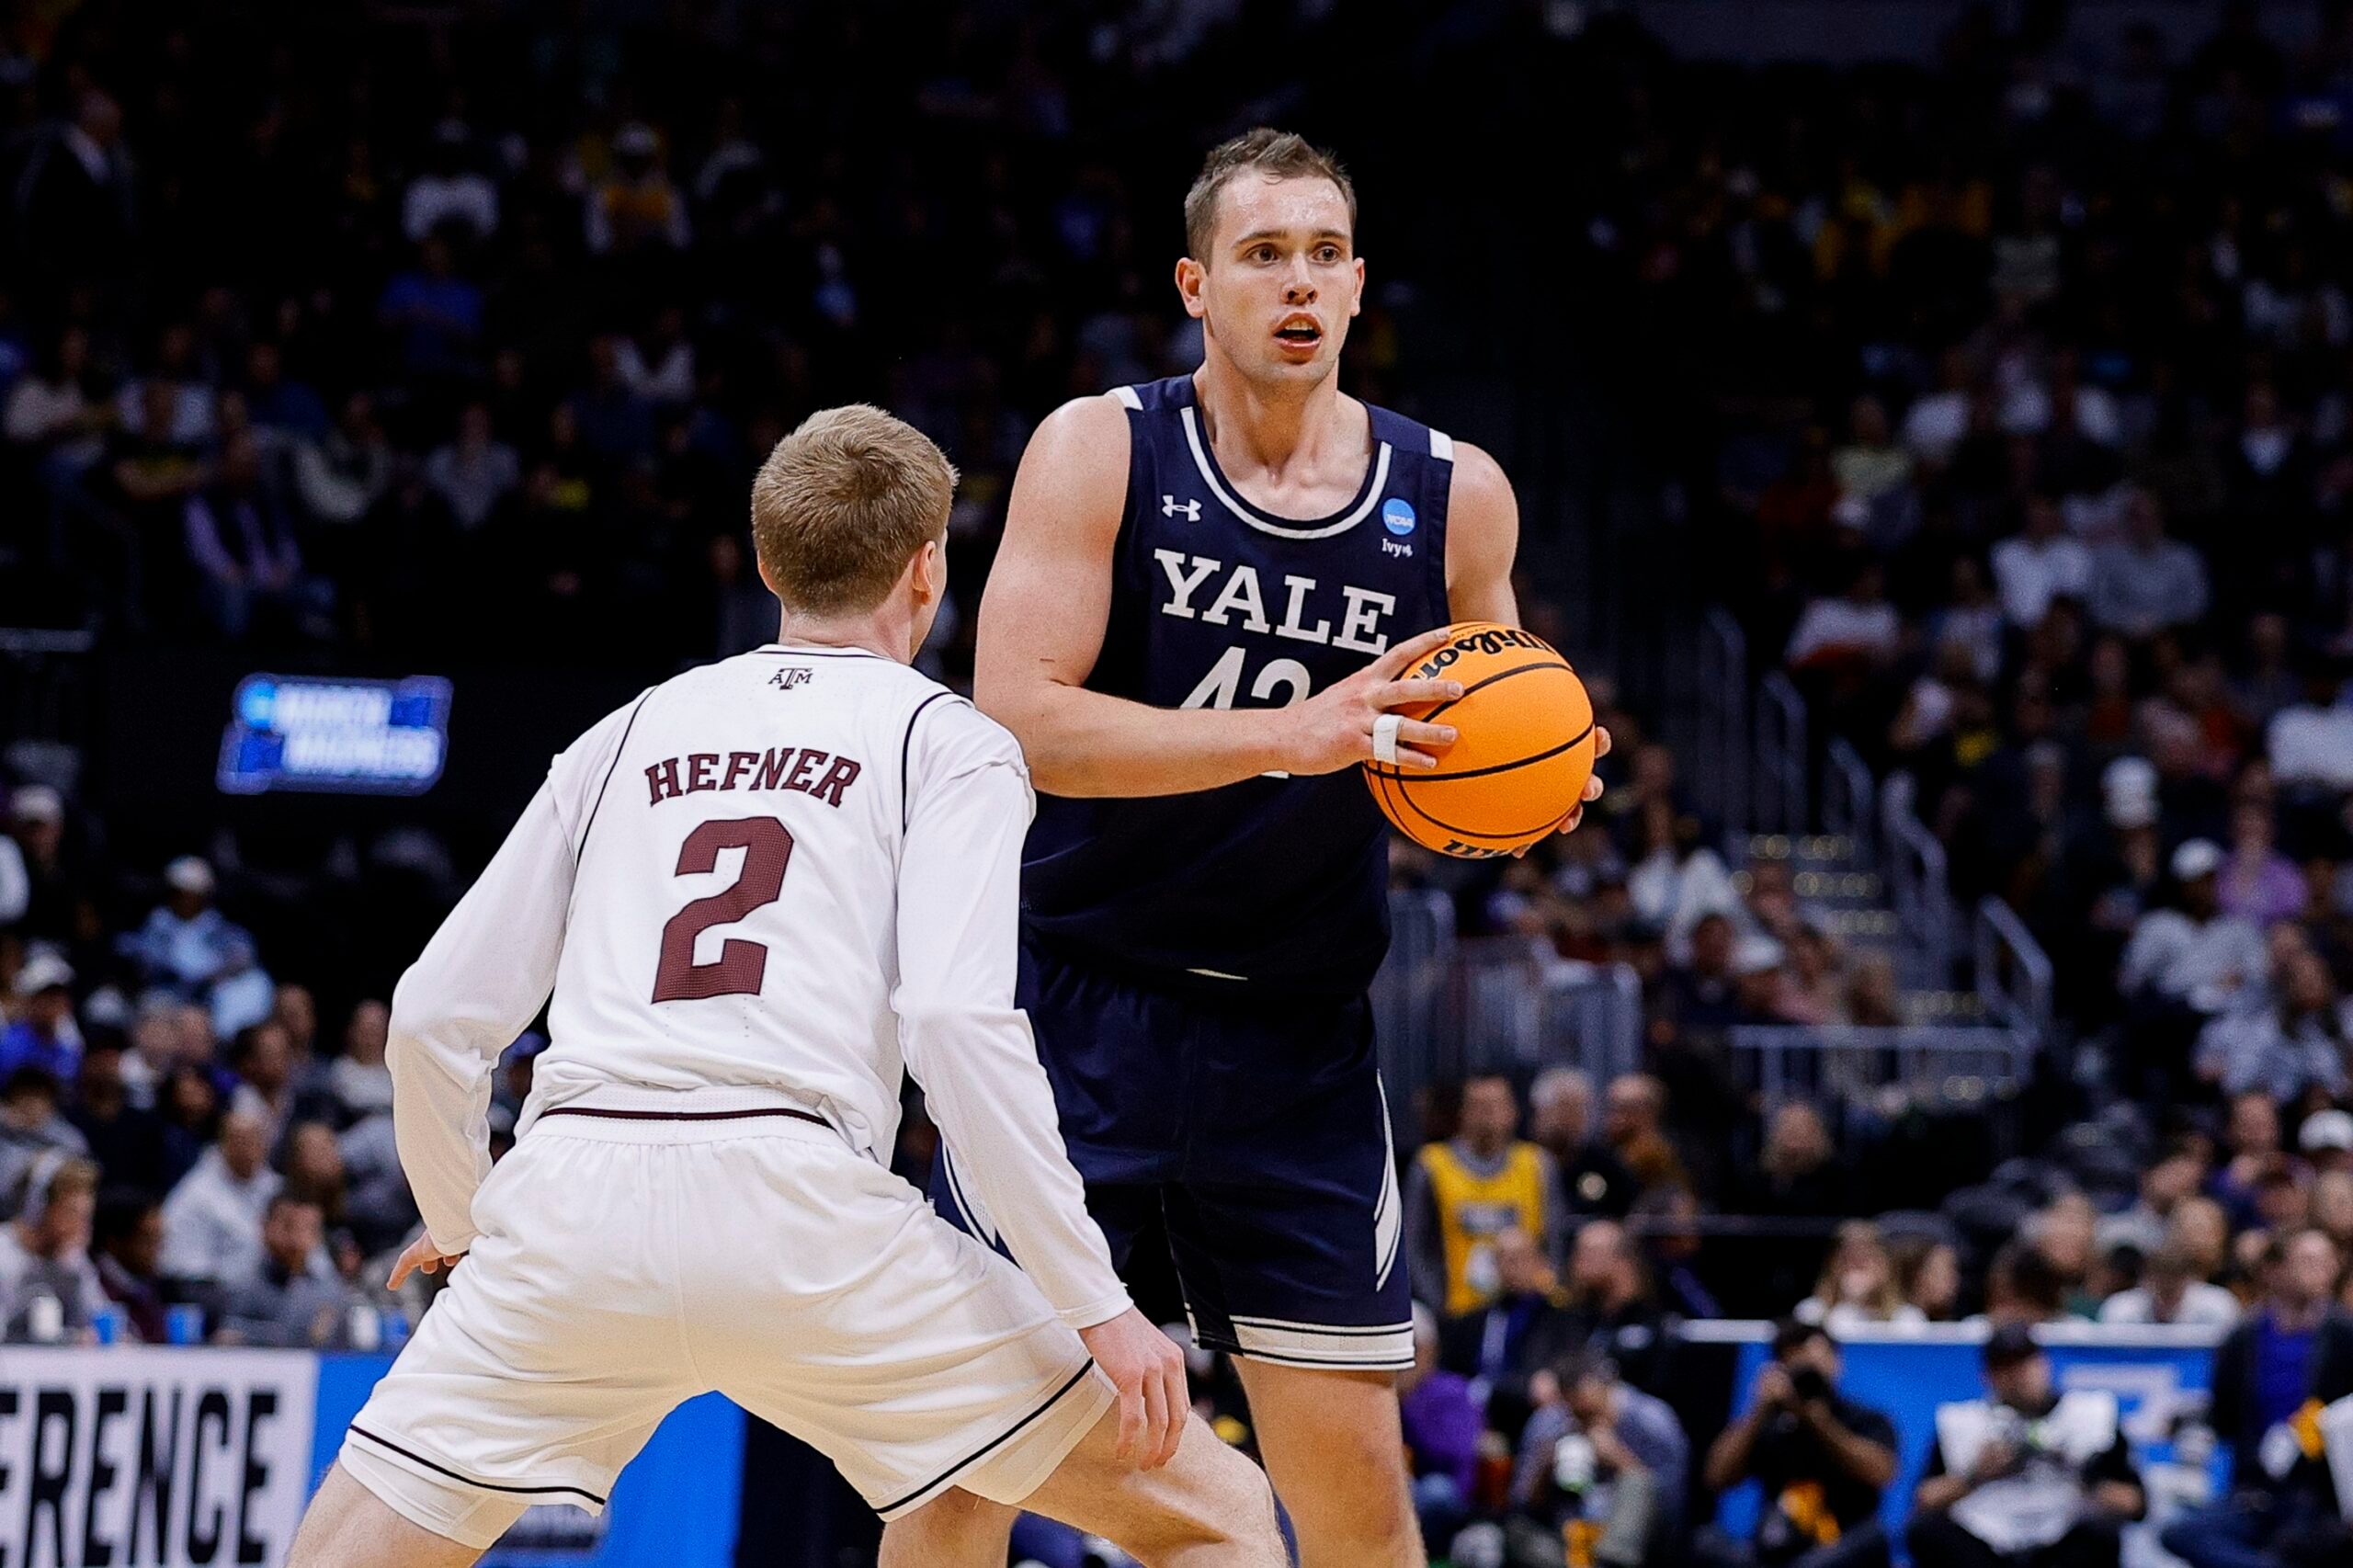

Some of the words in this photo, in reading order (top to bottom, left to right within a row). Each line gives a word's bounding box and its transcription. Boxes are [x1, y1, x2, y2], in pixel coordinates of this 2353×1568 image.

[1154, 548, 1396, 656] YALE
[644, 747, 861, 808] HEFNER
[651, 816, 794, 1004] 2
